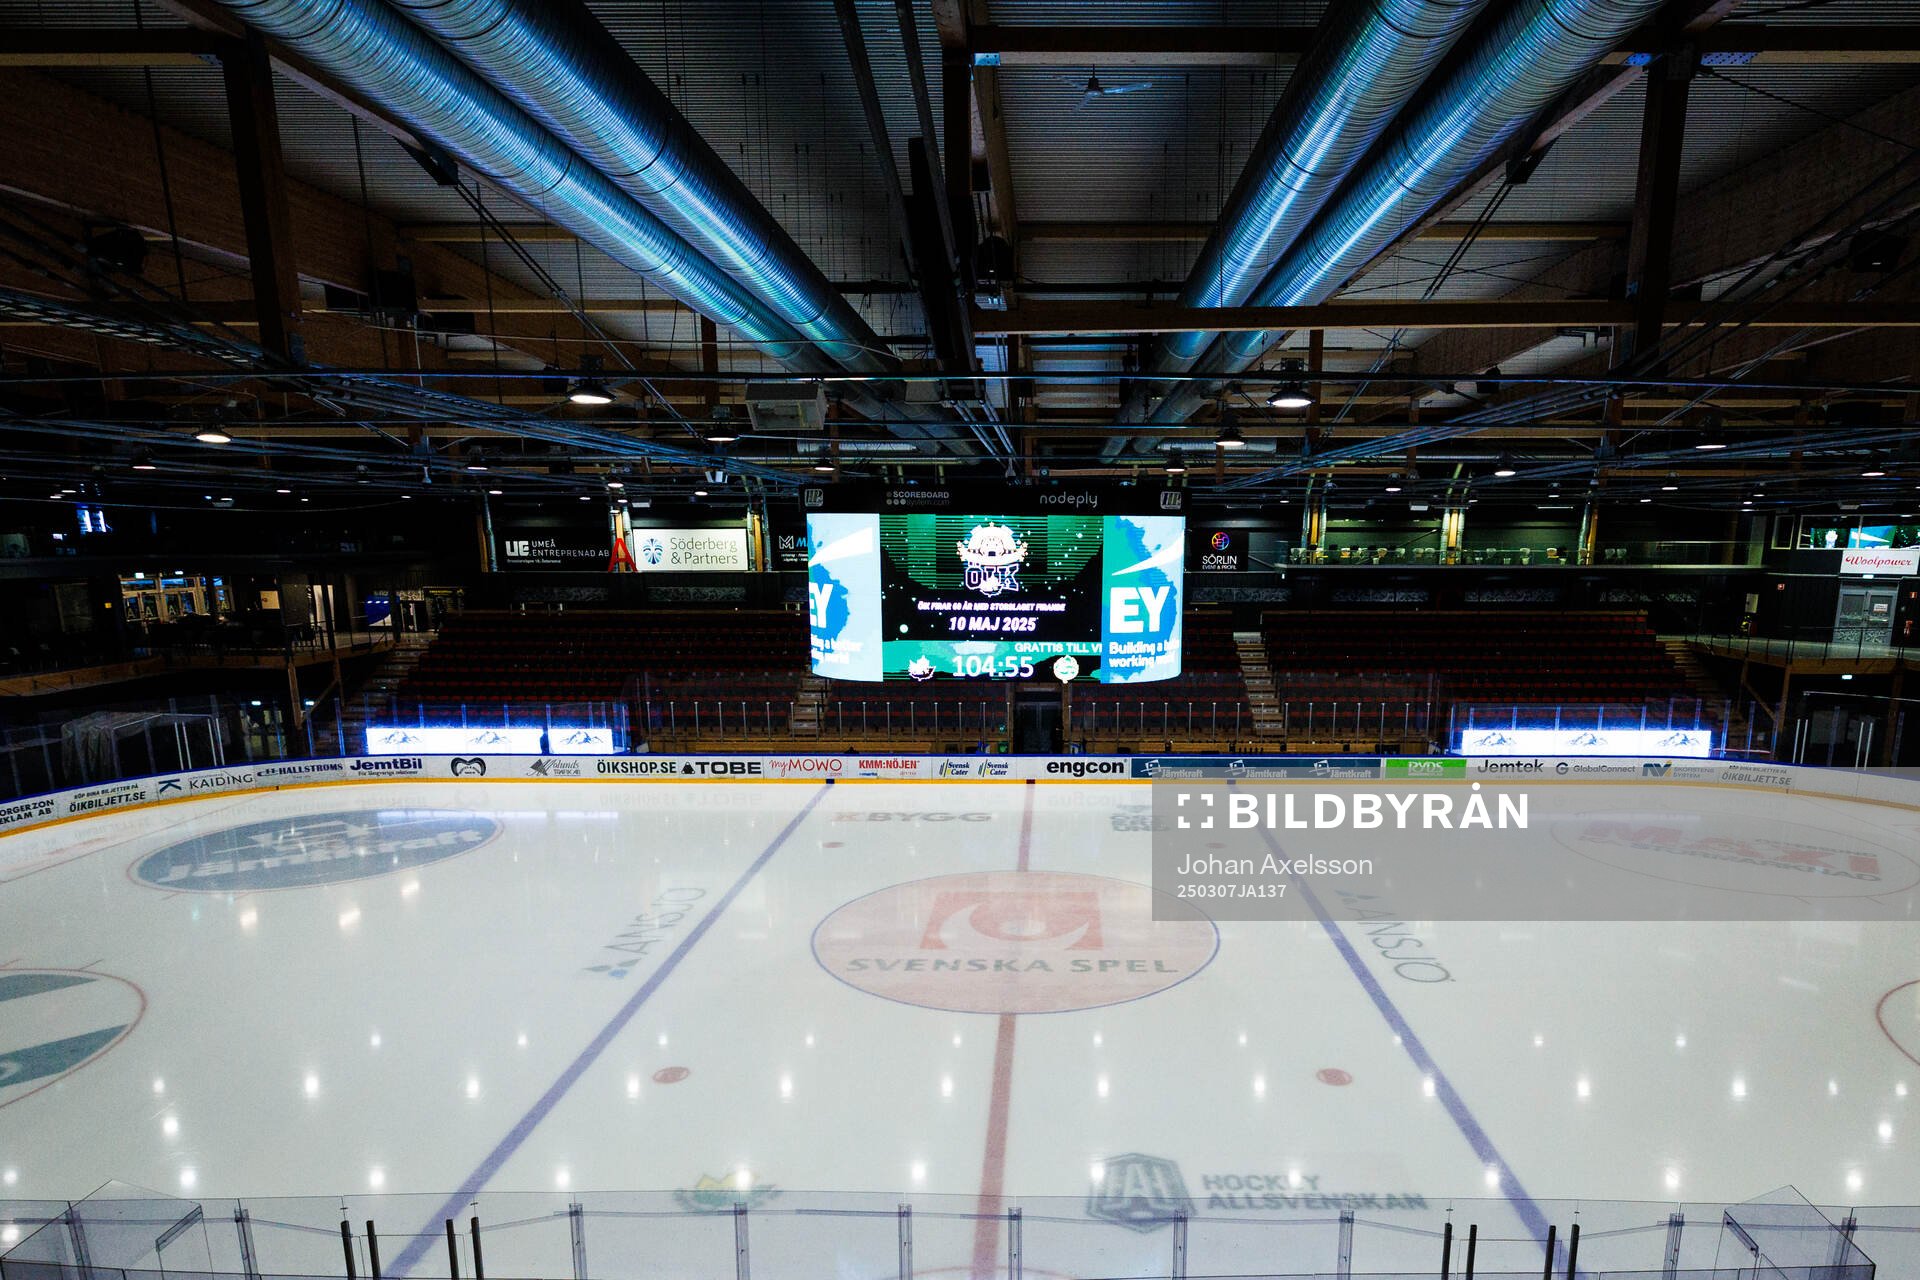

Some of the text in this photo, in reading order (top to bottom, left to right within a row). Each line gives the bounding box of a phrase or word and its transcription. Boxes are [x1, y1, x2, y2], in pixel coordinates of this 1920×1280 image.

[892, 490, 950, 499] SCOREBOARD
[1039, 491, 1098, 508] nodeply
[531, 538, 556, 548] UMEÅ
[670, 536, 737, 553] Söderberg
[532, 549, 610, 557] ENTREPRENAD AB
[670, 552, 738, 565] & Partners
[1202, 553, 1237, 565] SÖRLIN
[1845, 555, 1912, 569] Woolpower
[1109, 586, 1170, 634] EY
[949, 617, 1036, 632] 10 MAJ 2025
[1015, 643, 1063, 653] GRATTIS
[1066, 643, 1090, 653] TILL
[1109, 640, 1156, 656] Building
[952, 656, 1034, 678] 104:55
[350, 758, 423, 771] JemtBil
[597, 759, 677, 774] ÖIKSHOP.SE
[695, 761, 762, 775] TOBE
[858, 758, 917, 769] KMM:NÖJEN
[948, 761, 970, 769] Svensk
[987, 761, 1009, 769] Svensk
[1046, 761, 1125, 777] engcon
[1477, 759, 1544, 774] Jemtek
[1573, 764, 1636, 773] GlobalConnect
[1161, 769, 1203, 779] Jämtkraft
[1245, 769, 1287, 779] Jämtkraft
[1330, 769, 1372, 779] Jämtkraft
[1721, 770, 1793, 786] ÖIKBILJETT.SE
[189, 774, 253, 789] KAIDING
[69, 791, 146, 813] ÖIKBILJETT.SE
[38, 808, 51, 816] AB
[847, 958, 1179, 973] SVENSKA SPEL
[1207, 1193, 1430, 1210] ALLSVENSKAN
